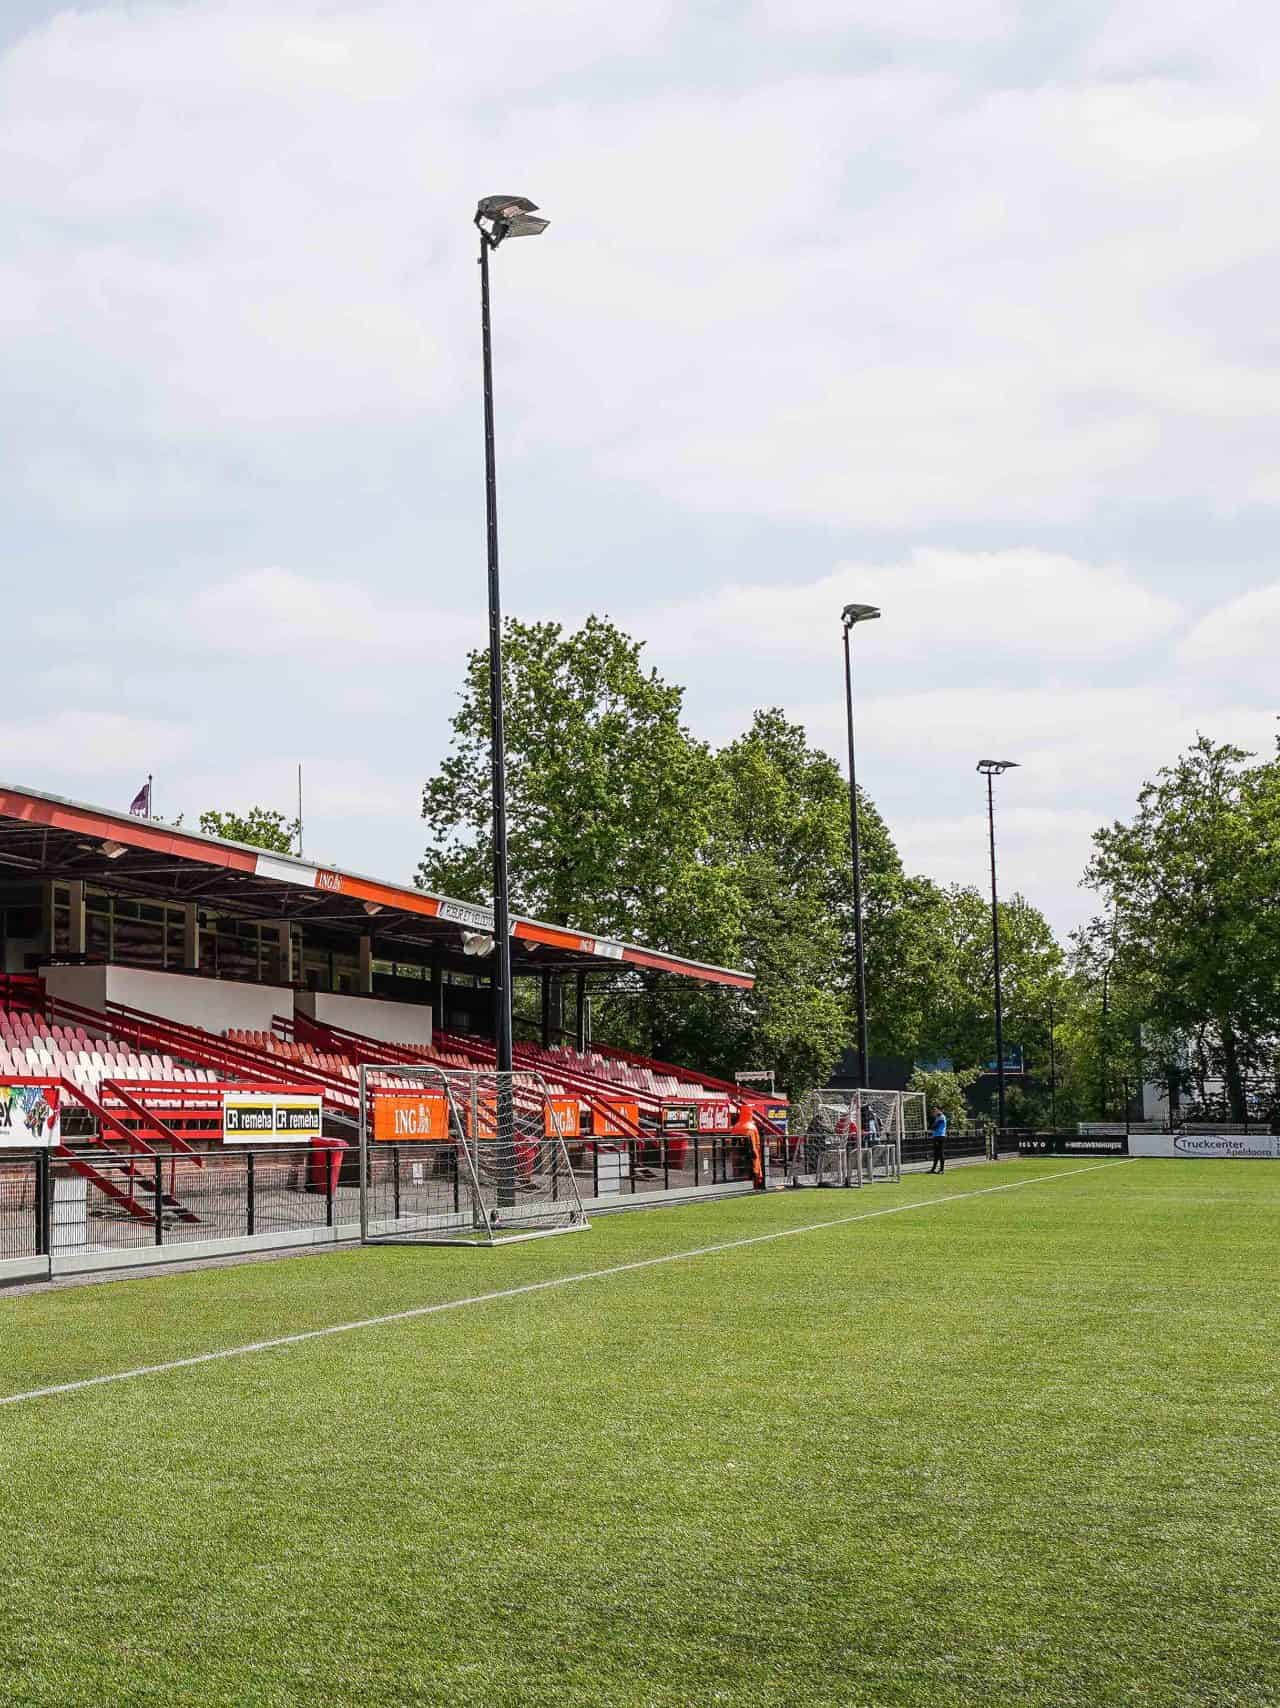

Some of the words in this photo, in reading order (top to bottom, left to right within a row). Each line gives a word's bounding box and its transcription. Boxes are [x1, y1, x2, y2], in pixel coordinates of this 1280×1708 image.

[241, 1110, 272, 1129] remeha
[290, 1110, 319, 1129] remeha
[394, 1109, 417, 1134] ING
[1182, 1139, 1244, 1149] Truckcenter
